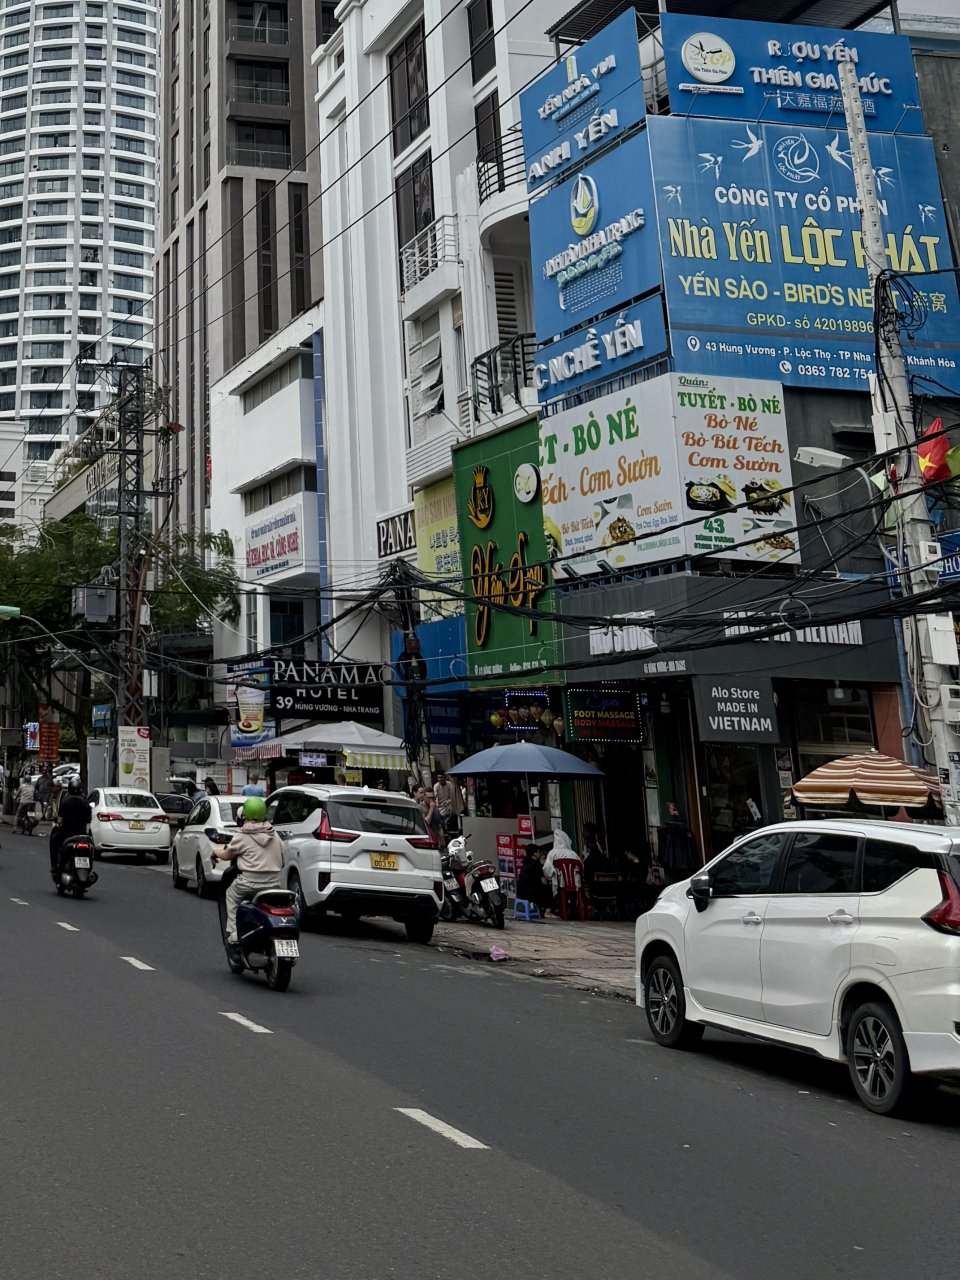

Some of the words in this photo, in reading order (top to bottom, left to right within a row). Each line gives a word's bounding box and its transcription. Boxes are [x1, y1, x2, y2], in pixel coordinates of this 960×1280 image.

[768, 39, 821, 62] RỢU
[823, 37, 858, 63] YẾN
[749, 65, 802, 88] THIÊN
[805, 71, 839, 92] GIA
[857, 71, 893, 95] HÚC
[782, 91, 875, 114] 天嘉福燕酒
[573, 107, 619, 150] YẾN
[714, 183, 769, 208] CÔNG
[774, 191, 798, 209] TY
[804, 186, 831, 212] CỔ
[837, 196, 889, 216] PHN
[667, 217, 718, 261] Nhà
[722, 217, 773, 265] Yến
[780, 216, 847, 272] LỘC
[678, 270, 720, 297] YẾN
[725, 274, 768, 301] SÀO
[783, 282, 845, 307] BIRD'S
[848, 287, 900, 310] NET
[795, 313, 811, 329] số
[601, 311, 644, 360] YẾN
[705, 341, 717, 352] 43
[719, 341, 743, 355] Hùng
[745, 344, 776, 357] Vương
[783, 347, 793, 357] P.
[795, 347, 812, 360] Lộc
[813, 348, 831, 361] Thọ
[839, 350, 851, 360] TP
[853, 350, 871, 362] Nha
[907, 355, 936, 368] Khánh
[938, 356, 956, 369] Hòa
[677, 375, 709, 387] Quán:
[798, 364, 826, 377] 0363
[829, 366, 851, 379] 782
[677, 388, 727, 410] TUYẾT
[738, 391, 758, 413] BÒ
[761, 395, 782, 415] NÉ
[572, 411, 602, 457] BÒ
[606, 397, 640, 446] NÉ
[704, 413, 729, 430] Bò
[733, 415, 759, 432] Né
[681, 431, 707, 448] Bò
[711, 432, 741, 450] Bít
[742, 435, 785, 454] Tếch
[688, 451, 729, 469] Cơm
[733, 455, 782, 473] Sườn
[541, 471, 569, 506] ếch
[579, 466, 613, 497] Cơm
[617, 449, 662, 487] Sườn
[379, 512, 416, 558] PANA
[703, 517, 726, 534] 43
[273, 660, 378, 685] PANAMA
[276, 696, 293, 709] 39
[295, 701, 314, 711] HÙNG
[343, 705, 357, 713] NHA
[357, 706, 380, 714] TRANG
[711, 686, 729, 698] Alo
[731, 687, 760, 700] Store
[574, 710, 595, 718] FOOT
[597, 711, 635, 719] MASSAGE
[716, 701, 744, 713] MADE
[746, 702, 759, 713] IN
[709, 715, 773, 732] VIETNAM
